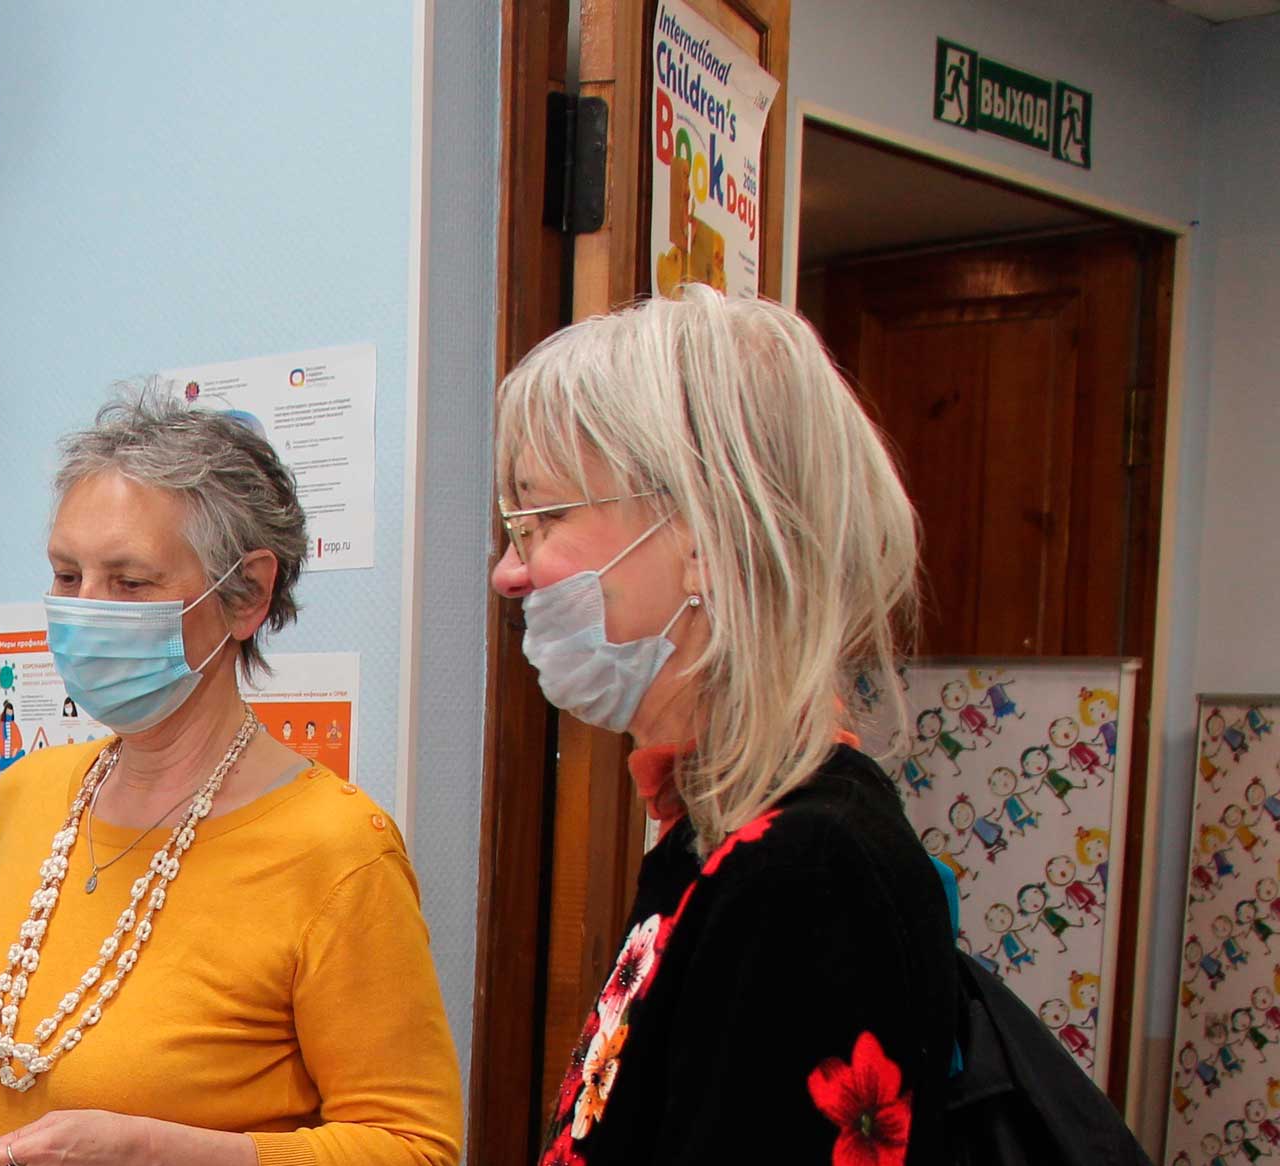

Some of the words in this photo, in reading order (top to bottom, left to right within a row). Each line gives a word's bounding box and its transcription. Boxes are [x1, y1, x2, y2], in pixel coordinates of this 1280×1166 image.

[658, 5, 732, 86] International
[657, 41, 737, 143] Children's
[980, 78, 1048, 142] ВЫХОД
[656, 86, 725, 208] Book
[727, 173, 756, 241] Day
[323, 541, 351, 554] crpp.ru
[0, 640, 16, 650] Меры
